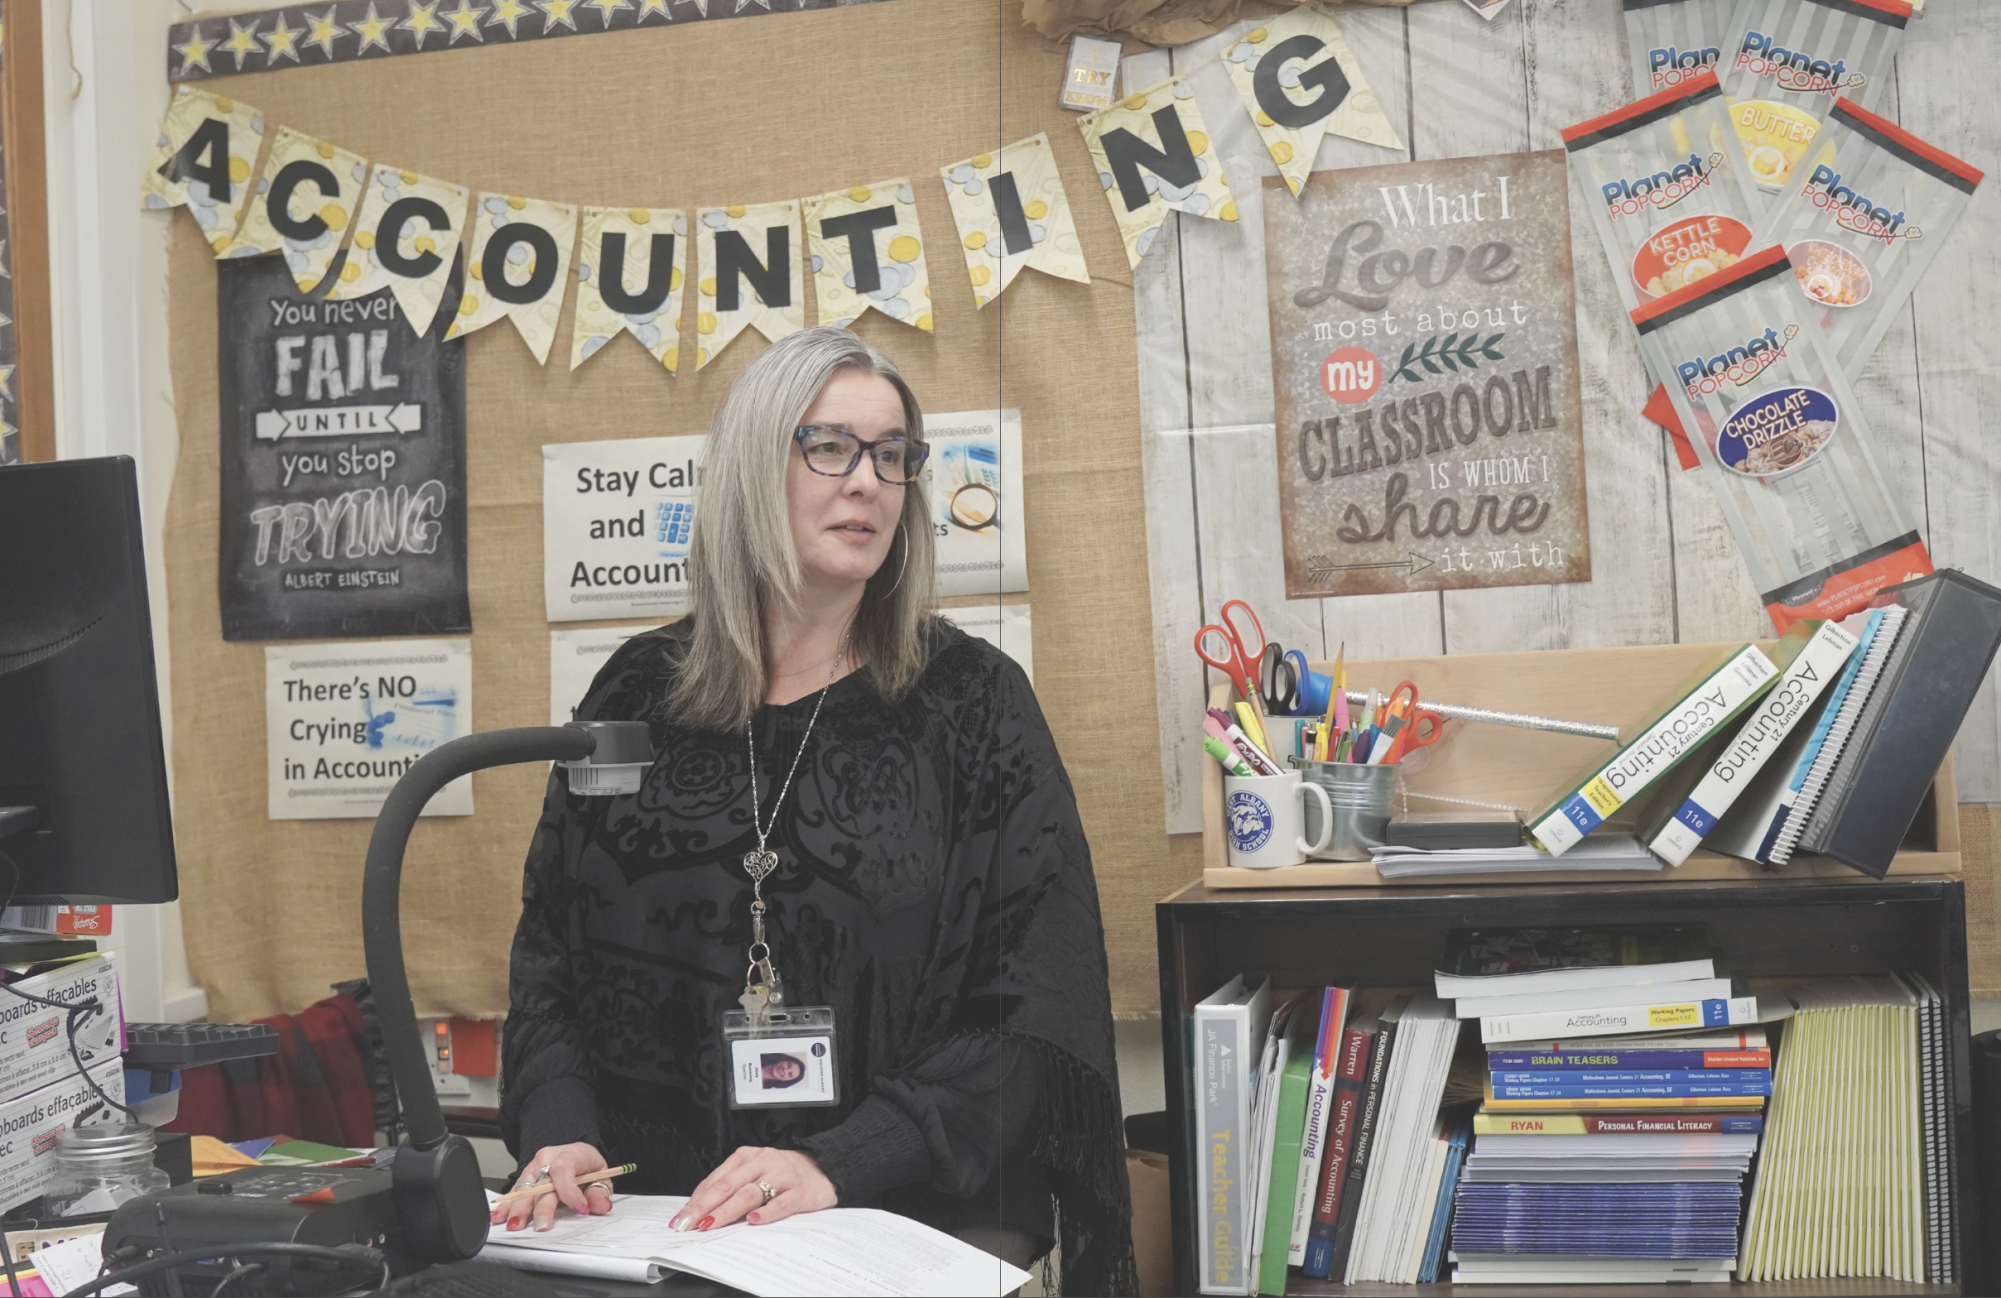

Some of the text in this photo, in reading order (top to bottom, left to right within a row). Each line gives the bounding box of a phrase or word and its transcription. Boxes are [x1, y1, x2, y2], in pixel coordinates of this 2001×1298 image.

[1653, 63, 1717, 88] POPC
[1736, 54, 1840, 97] POPCORN
[1741, 31, 1846, 86] Planet
[1074, 68, 1111, 85] TRY
[1065, 91, 1109, 107] KNOW
[1741, 107, 1817, 145] BUTTER
[157, 34, 1351, 315] ACCOUNTING
[1602, 154, 1703, 206] Planet
[1378, 176, 1512, 229] What I
[1610, 172, 1710, 220] POPCORN
[1808, 164, 1905, 234] Planet
[1800, 184, 1896, 245] POPCORN
[1650, 217, 1721, 254] KETTLE
[1664, 237, 1716, 266] CORN
[1293, 220, 1520, 311] Love
[271, 297, 400, 325] You never
[1314, 300, 1527, 341] most about
[275, 330, 399, 400] FAIL
[1678, 327, 1780, 387] Planet
[1687, 343, 1788, 402] POPCORN
[1327, 359, 1374, 392] my
[297, 409, 377, 430] UNTIL
[1299, 365, 1557, 481] CLASSROOM
[1726, 390, 1810, 438] CHOCOLATE
[1743, 411, 1806, 450] DRIZZLE
[283, 445, 396, 486] you stop
[577, 467, 640, 498] Stay
[1430, 455, 1550, 490] IS WHOM I
[251, 480, 446, 566] TRYING
[590, 510, 645, 539] and
[1336, 473, 1550, 545] share
[1440, 542, 1564, 573] it with
[286, 570, 399, 588] ALBERT EINSTEIN
[1822, 634, 1843, 651] Lehman
[1825, 624, 1852, 646] Gilbertson
[1746, 652, 1768, 677] Gilbertson
[284, 676, 416, 702] There’s NO
[290, 718, 366, 745] Crying
[1713, 660, 1819, 784] Accounting
[1770, 693, 1810, 742] Century 21
[1235, 742, 1261, 766] EXPO
[1606, 686, 1727, 790] Accounting
[1668, 717, 1714, 758] Century 21
[285, 758, 305, 780] in
[1240, 793, 1270, 817] ALBANY
[1571, 805, 1588, 826] 11e
[1589, 793, 1605, 810] Edition
[1685, 810, 1704, 829] 11e
[1242, 829, 1270, 851] SCHOOL
[72, 915, 101, 931] Sharpie
[1567, 1016, 1627, 1028] Accounting
[1651, 1007, 1695, 1016] Working Papers
[1655, 1015, 1679, 1023] Chapters
[1714, 1004, 1723, 1020] 11e
[1207, 1028, 1217, 1041] JA
[1208, 1043, 1217, 1079] Finance
[1347, 1036, 1362, 1075] Warren
[1372, 1031, 1388, 1082] FOUNDATIONS
[1531, 1056, 1618, 1065] BRAIN TEASERS
[47, 1083, 103, 1117] effaçables
[1362, 1091, 1376, 1130] PERSONAL
[1303, 1083, 1327, 1160] Accounting
[1511, 1121, 1543, 1131] RYAN
[1598, 1119, 1712, 1131] PERSONAL FINANCIAL LITERACY
[1321, 1100, 1352, 1214] Survey of Accounting
[1355, 1131, 1368, 1165] FINANCE
[1212, 1129, 1234, 1283] Teacher Guide
